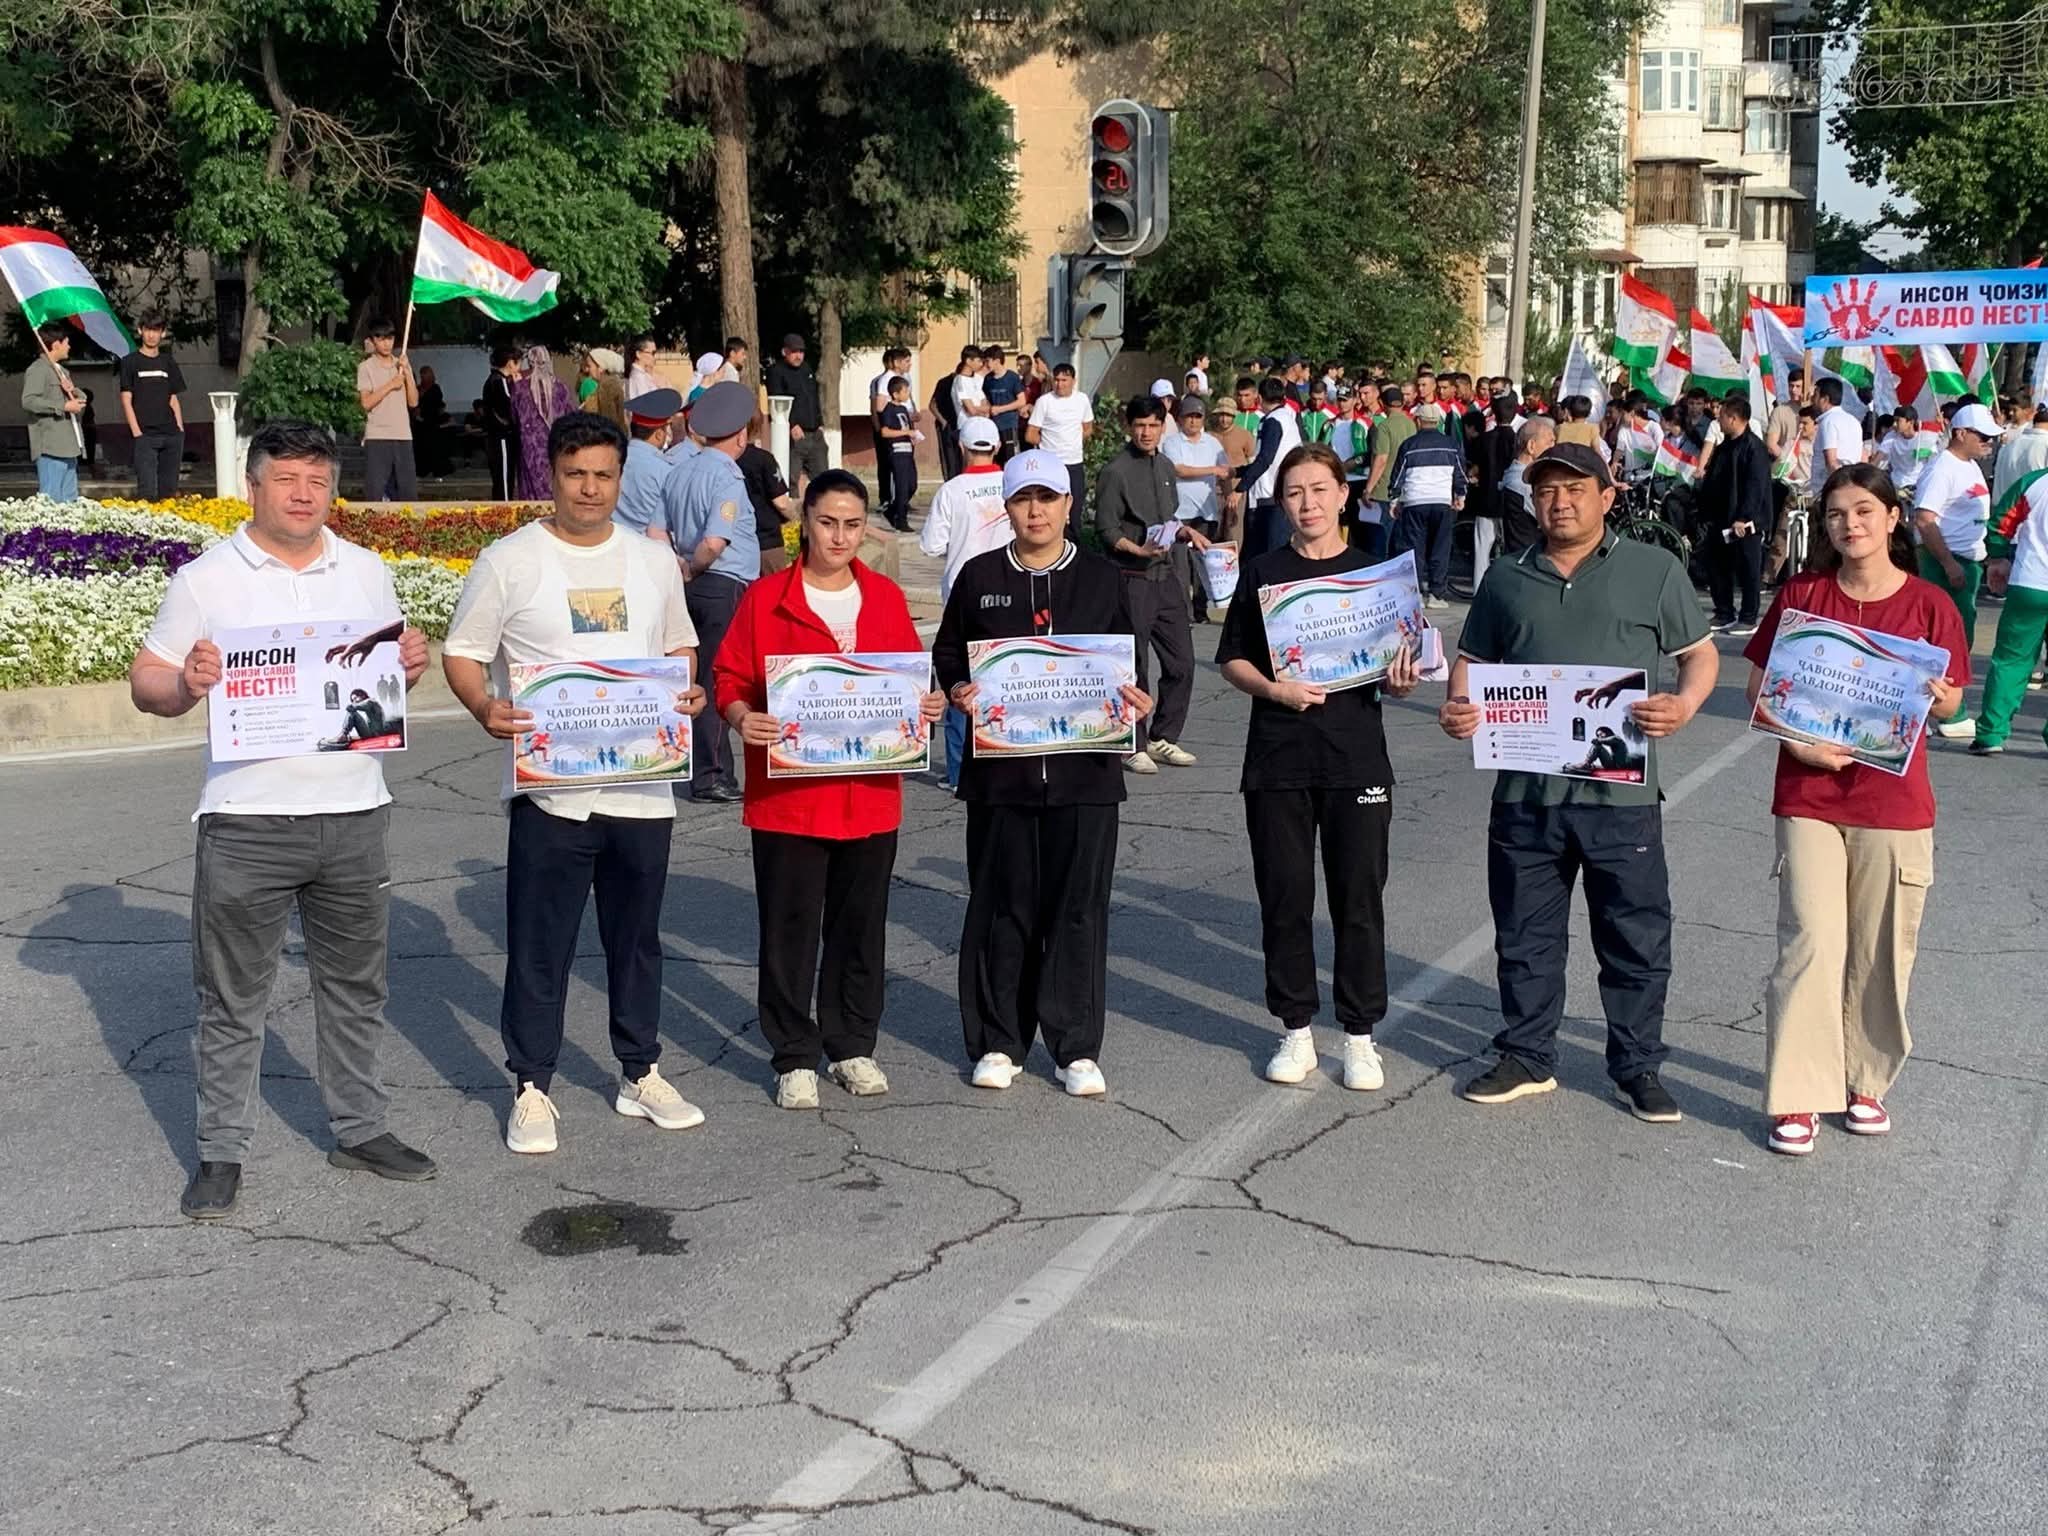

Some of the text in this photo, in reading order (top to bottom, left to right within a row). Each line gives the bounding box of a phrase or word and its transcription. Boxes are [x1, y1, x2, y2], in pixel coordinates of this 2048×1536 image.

[1900, 285, 1968, 304] ИНСОН
[1895, 306, 1975, 329] САВДО
[1359, 600, 1397, 620] ЗИДДИ
[1295, 610, 1400, 644] САВДОИ ОДАМОН
[226, 647, 296, 669] ИНСОН
[263, 665, 296, 676] САВДО
[226, 676, 297, 699] НЕСТ!!!
[1063, 677, 1104, 687] ЗИДДИ
[1863, 678, 1905, 699] ЗИДДИ
[1000, 689, 1107, 704] САВДОИ ОДАМОН
[1483, 685, 1547, 701] ИНСОН
[1792, 672, 1902, 712] САВДОИ ОДАМОН
[614, 703, 659, 715] ЗИДДИ
[860, 696, 902, 707] ЗИДДИ
[796, 708, 903, 721] САВДОИ ОДАМОН
[1486, 709, 1549, 724] НЕСТ!!!
[545, 716, 661, 732] САВДОИ ОДАМОН
